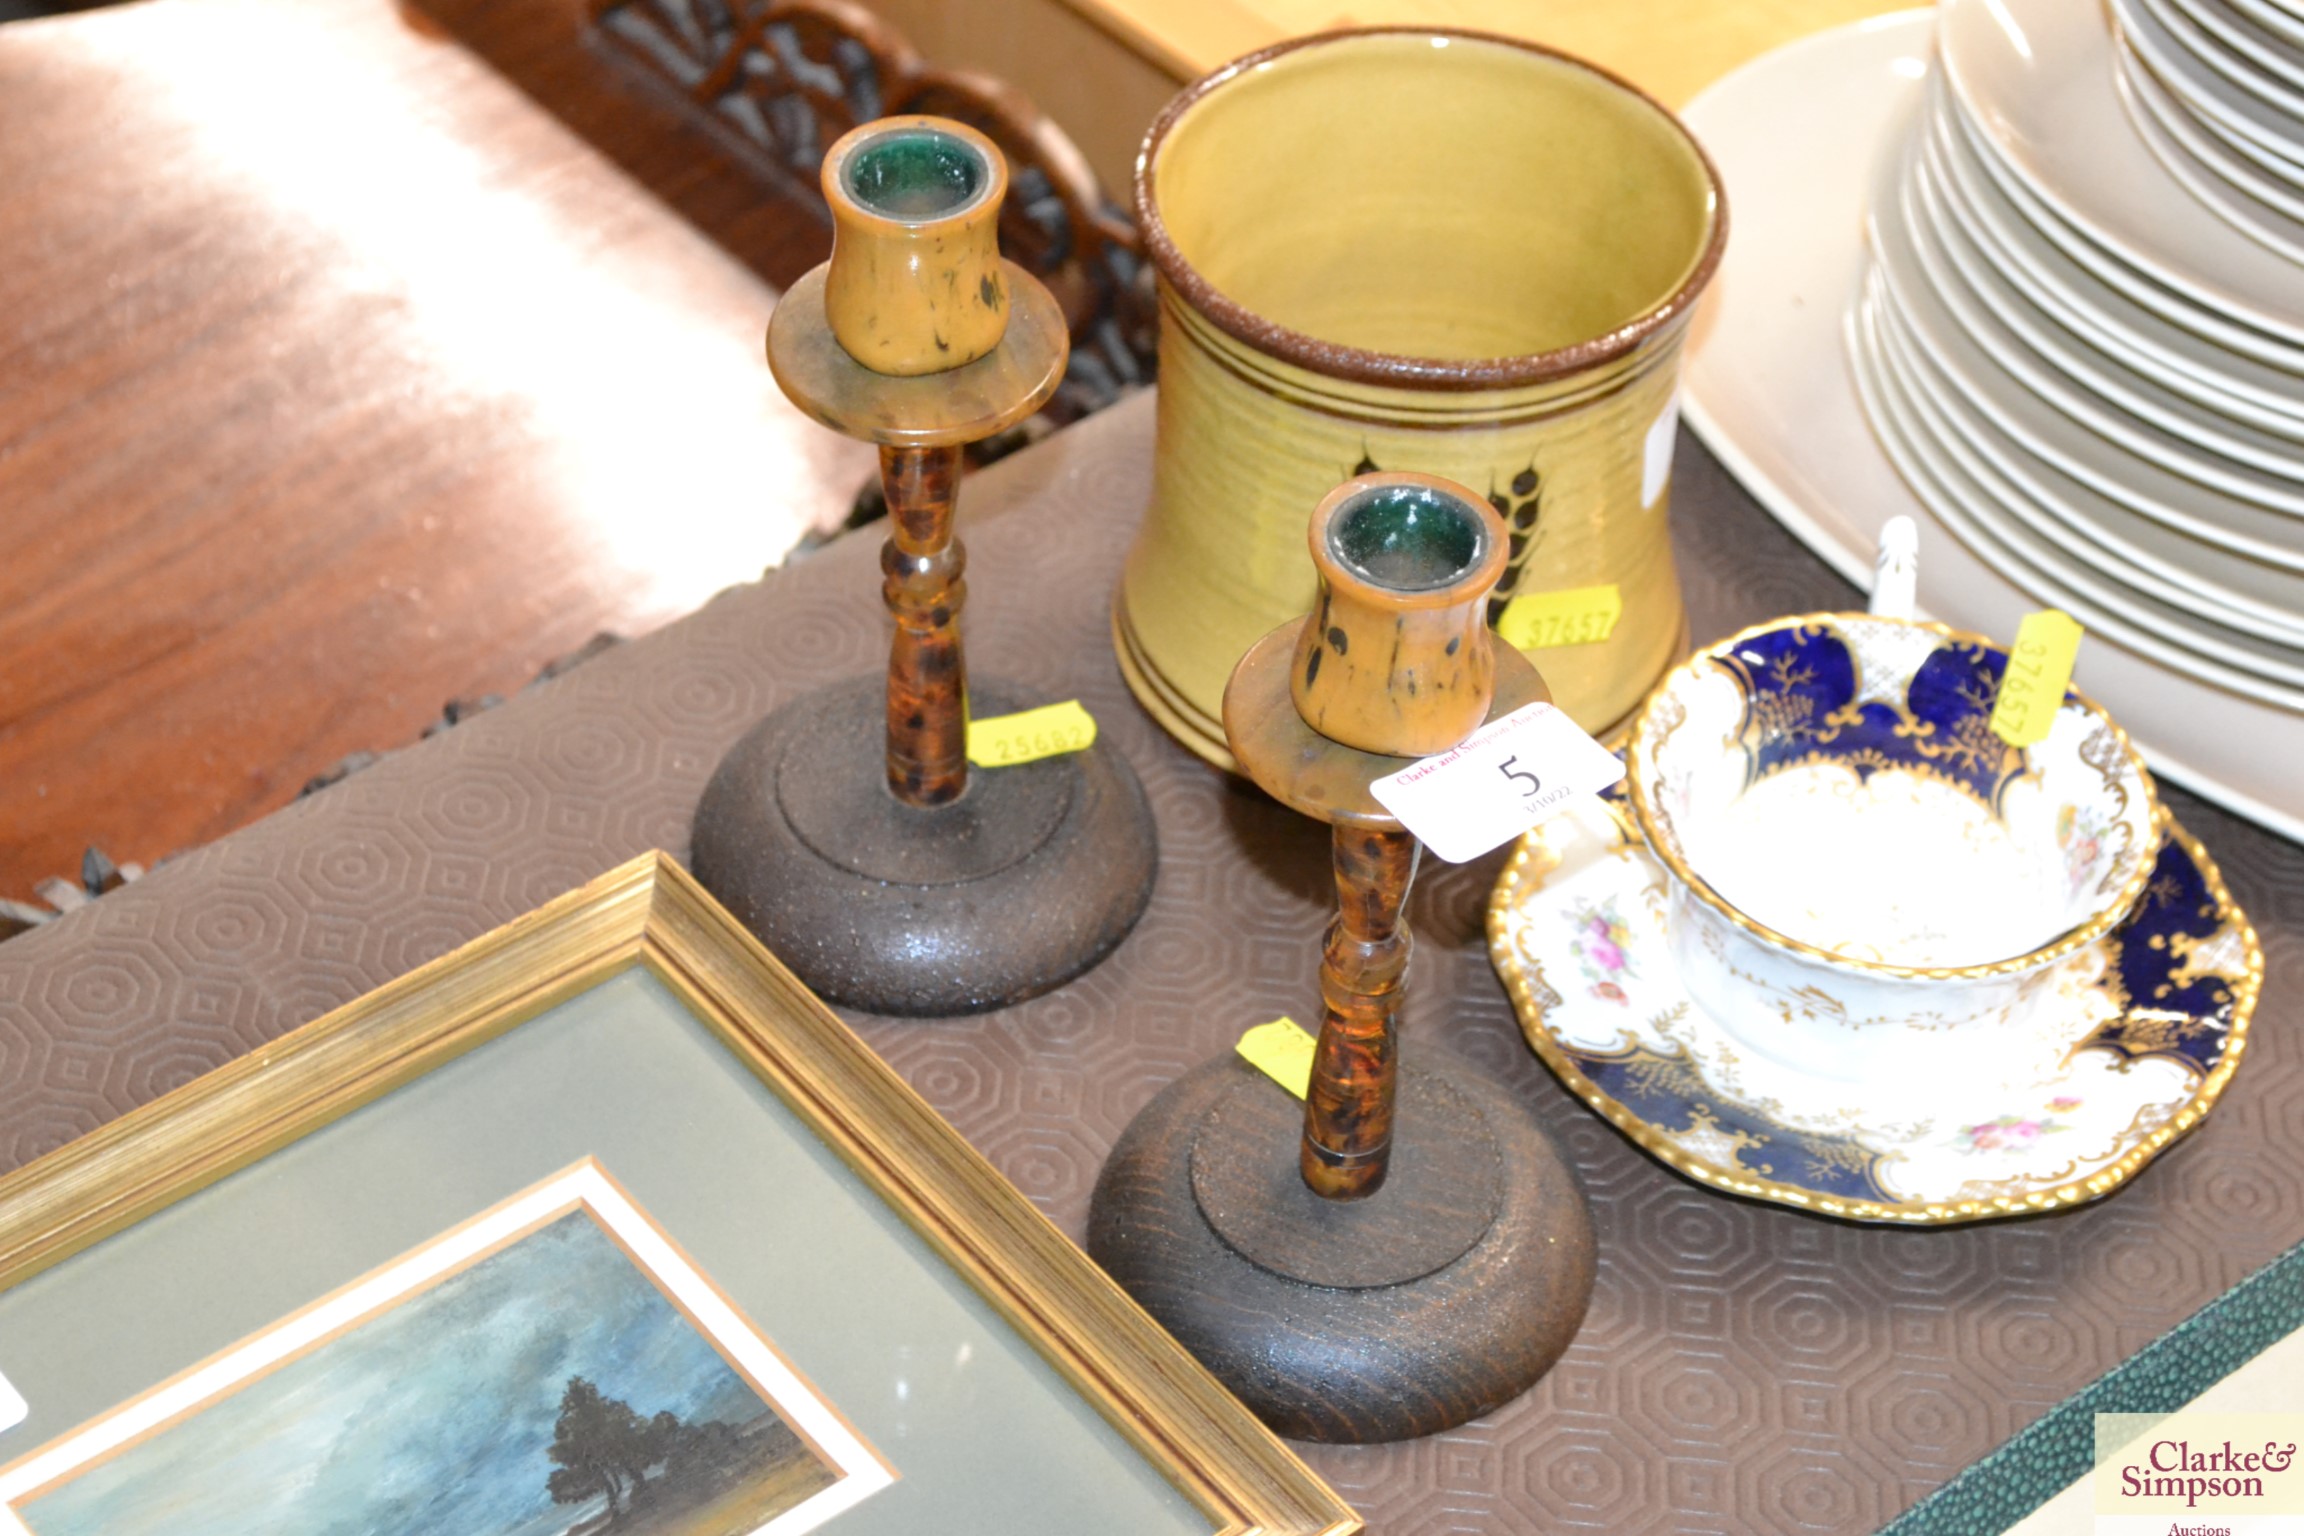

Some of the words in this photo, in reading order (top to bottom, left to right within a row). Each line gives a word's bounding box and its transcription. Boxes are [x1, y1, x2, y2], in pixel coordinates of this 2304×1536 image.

[1528, 611, 1611, 647] 37657
[1996, 640, 2047, 733] 37657
[994, 726, 1082, 760] 25682
[1396, 764, 1438, 786] Clarke
[1438, 750, 1461, 767] and
[1459, 726, 1510, 756] Simpson
[1498, 754, 1541, 797] 5
